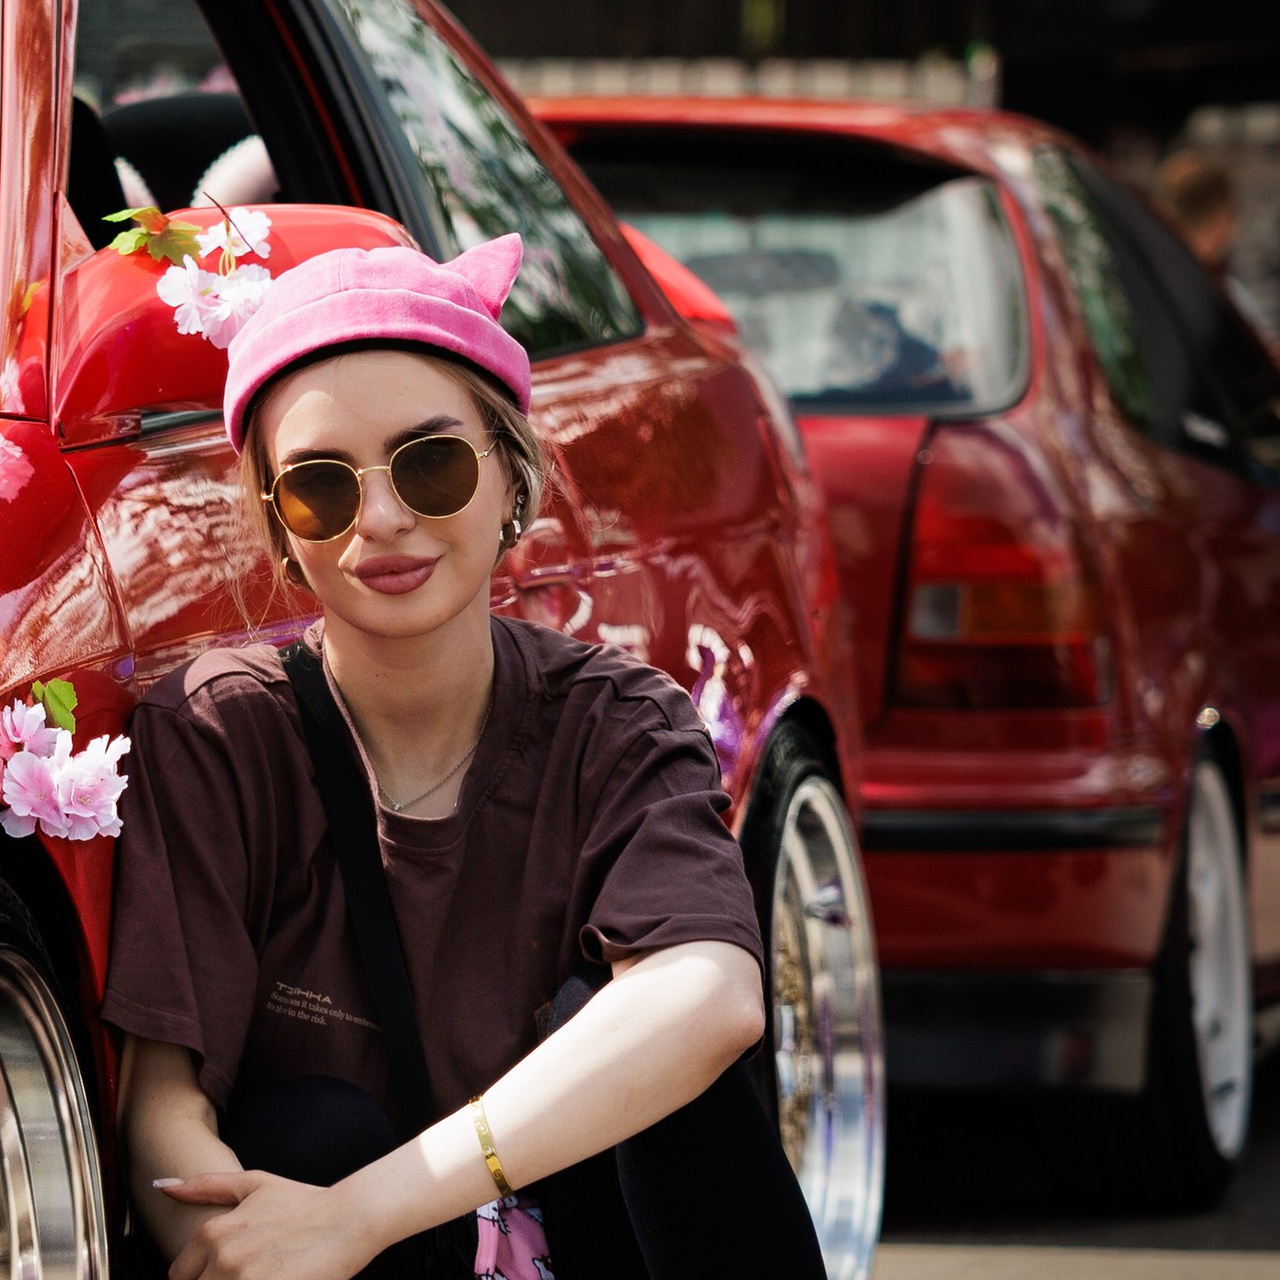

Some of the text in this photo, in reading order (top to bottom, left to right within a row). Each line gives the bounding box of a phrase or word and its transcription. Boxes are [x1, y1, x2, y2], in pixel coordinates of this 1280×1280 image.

[266, 1002, 275, 1011] to
[288, 1006, 297, 1017] in
[297, 1009, 310, 1020] the
[308, 1002, 328, 1014] takes
[329, 1007, 345, 1020] only
[345, 1012, 353, 1021] to
